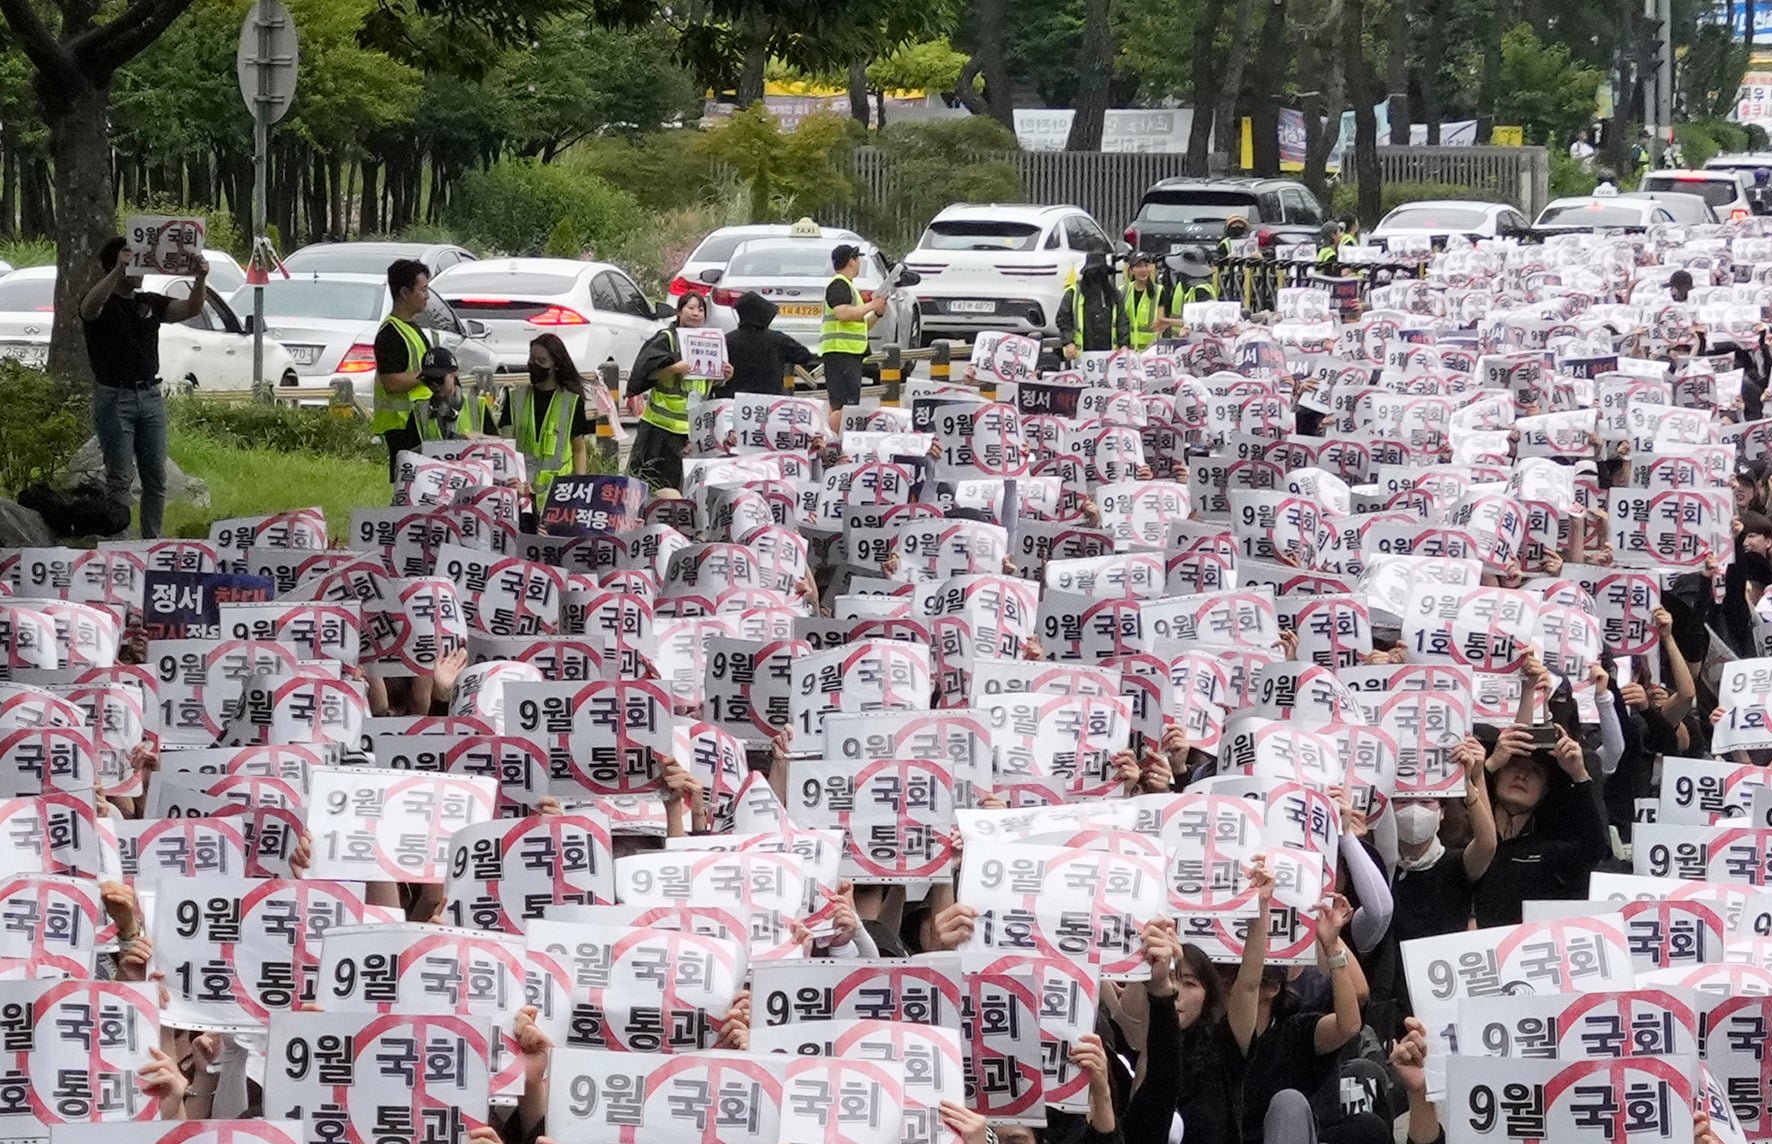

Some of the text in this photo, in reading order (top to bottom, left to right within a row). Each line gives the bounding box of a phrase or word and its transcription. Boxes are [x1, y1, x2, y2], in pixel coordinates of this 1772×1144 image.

[134, 227, 197, 247] 9월 국회
[133, 252, 196, 270] 1호 통과
[741, 401, 812, 427] 9월 국회
[1021, 390, 1051, 410] 정서
[741, 429, 812, 451] 1호 통과
[1524, 430, 1548, 446] 1호
[554, 482, 593, 503] 정서
[1617, 499, 1702, 526] 9월 국회
[151, 582, 205, 615] 정서
[1045, 613, 1142, 640] 9월 국회
[517, 693, 656, 734] 9월 국회
[323, 785, 474, 826] 9월 국회
[800, 772, 940, 813] 9월 국회
[1178, 810, 1247, 848] 국회
[1649, 843, 1707, 879] 9월
[980, 858, 1147, 902] 9월 국회
[174, 895, 244, 944] 9월
[980, 909, 1139, 957] 1호 통과
[1519, 933, 1613, 988] 국회
